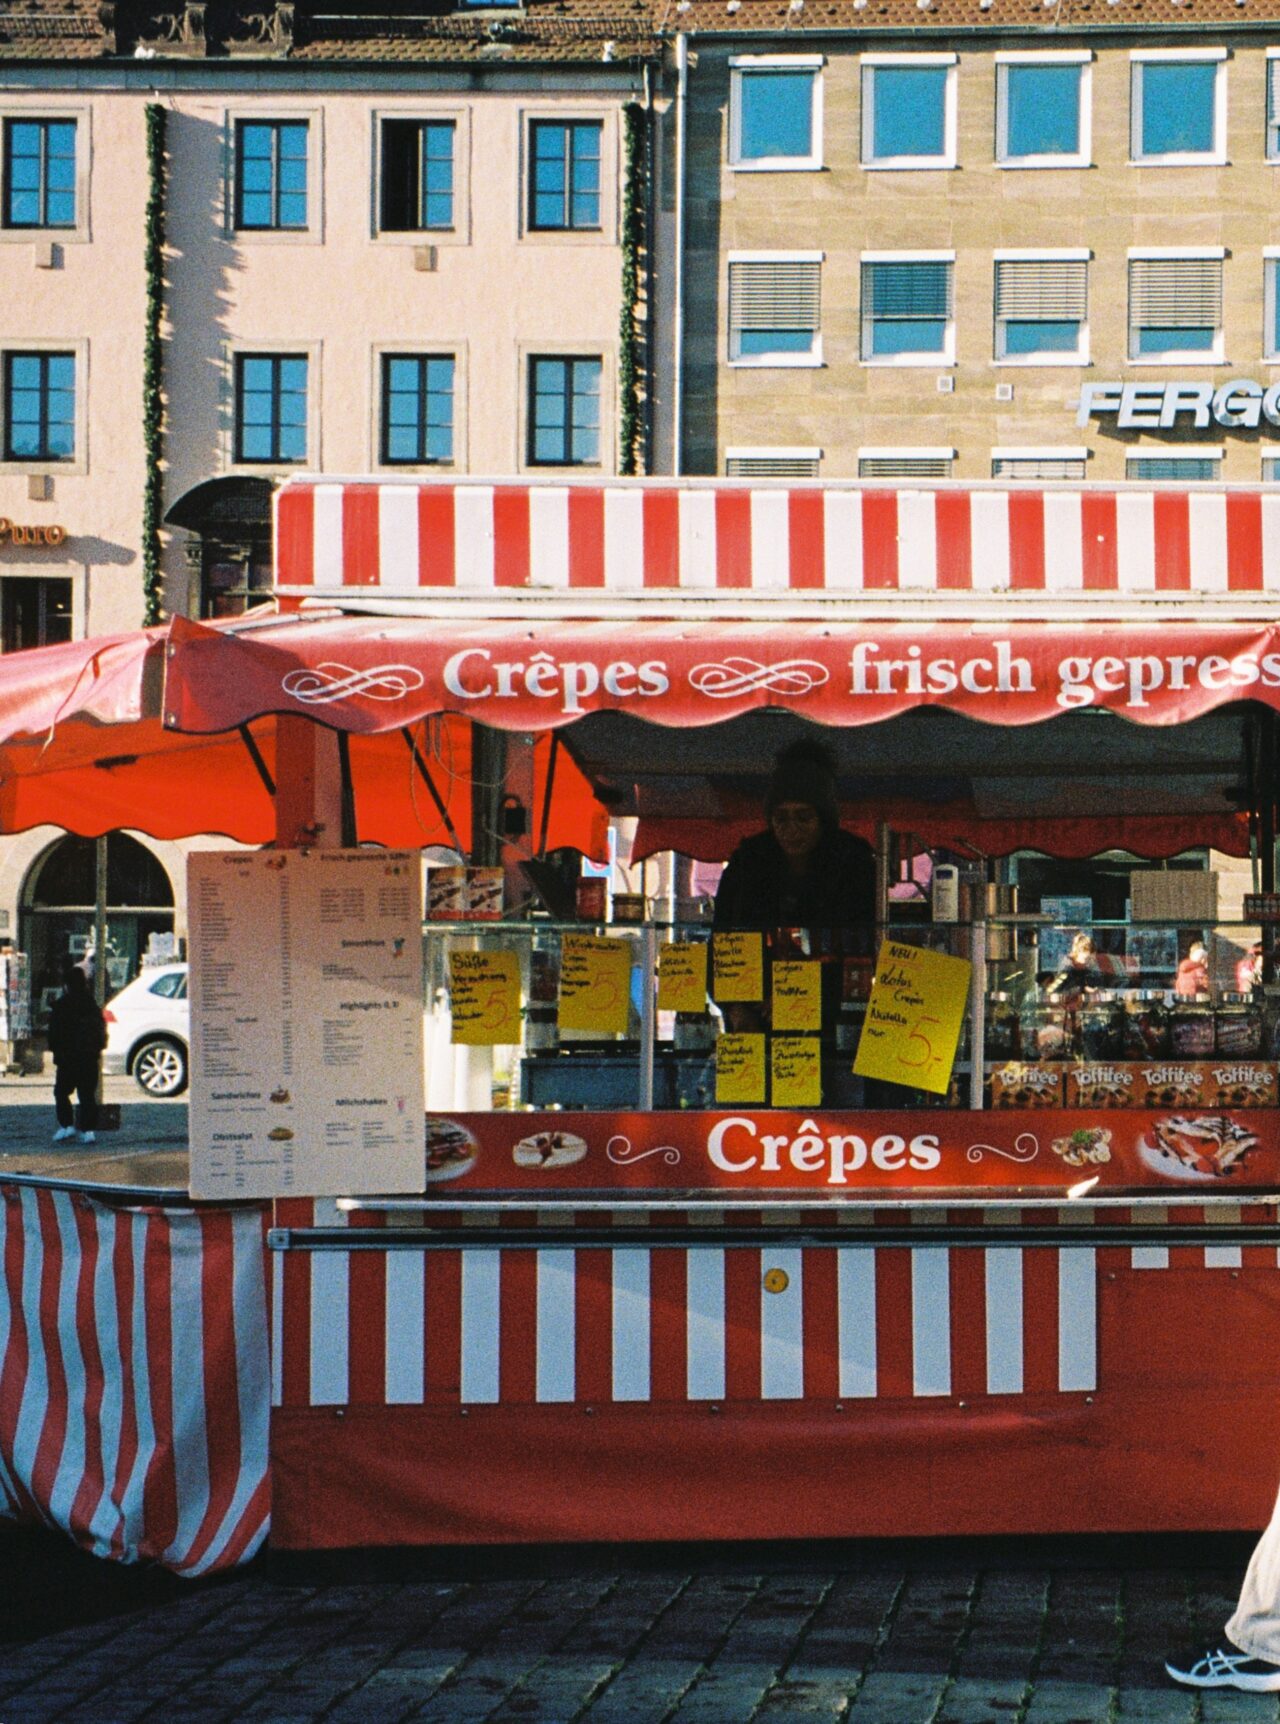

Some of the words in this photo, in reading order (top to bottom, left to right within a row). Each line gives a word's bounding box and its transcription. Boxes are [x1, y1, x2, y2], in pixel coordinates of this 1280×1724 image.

[849, 641, 1034, 695] frisch
[442, 647, 669, 713] Crêpes
[340, 1001, 382, 1012] Highlights
[870, 1007, 908, 1025] Nutella
[998, 1066, 1059, 1086] Toffifee
[1072, 1065, 1134, 1087] Toffifee
[1141, 1065, 1204, 1087] Toffifee
[1211, 1065, 1274, 1087] Toffifee
[211, 1092, 261, 1101] Sandwiches
[212, 1132, 253, 1141] Obstsalat
[707, 1116, 941, 1184] Crêpes
